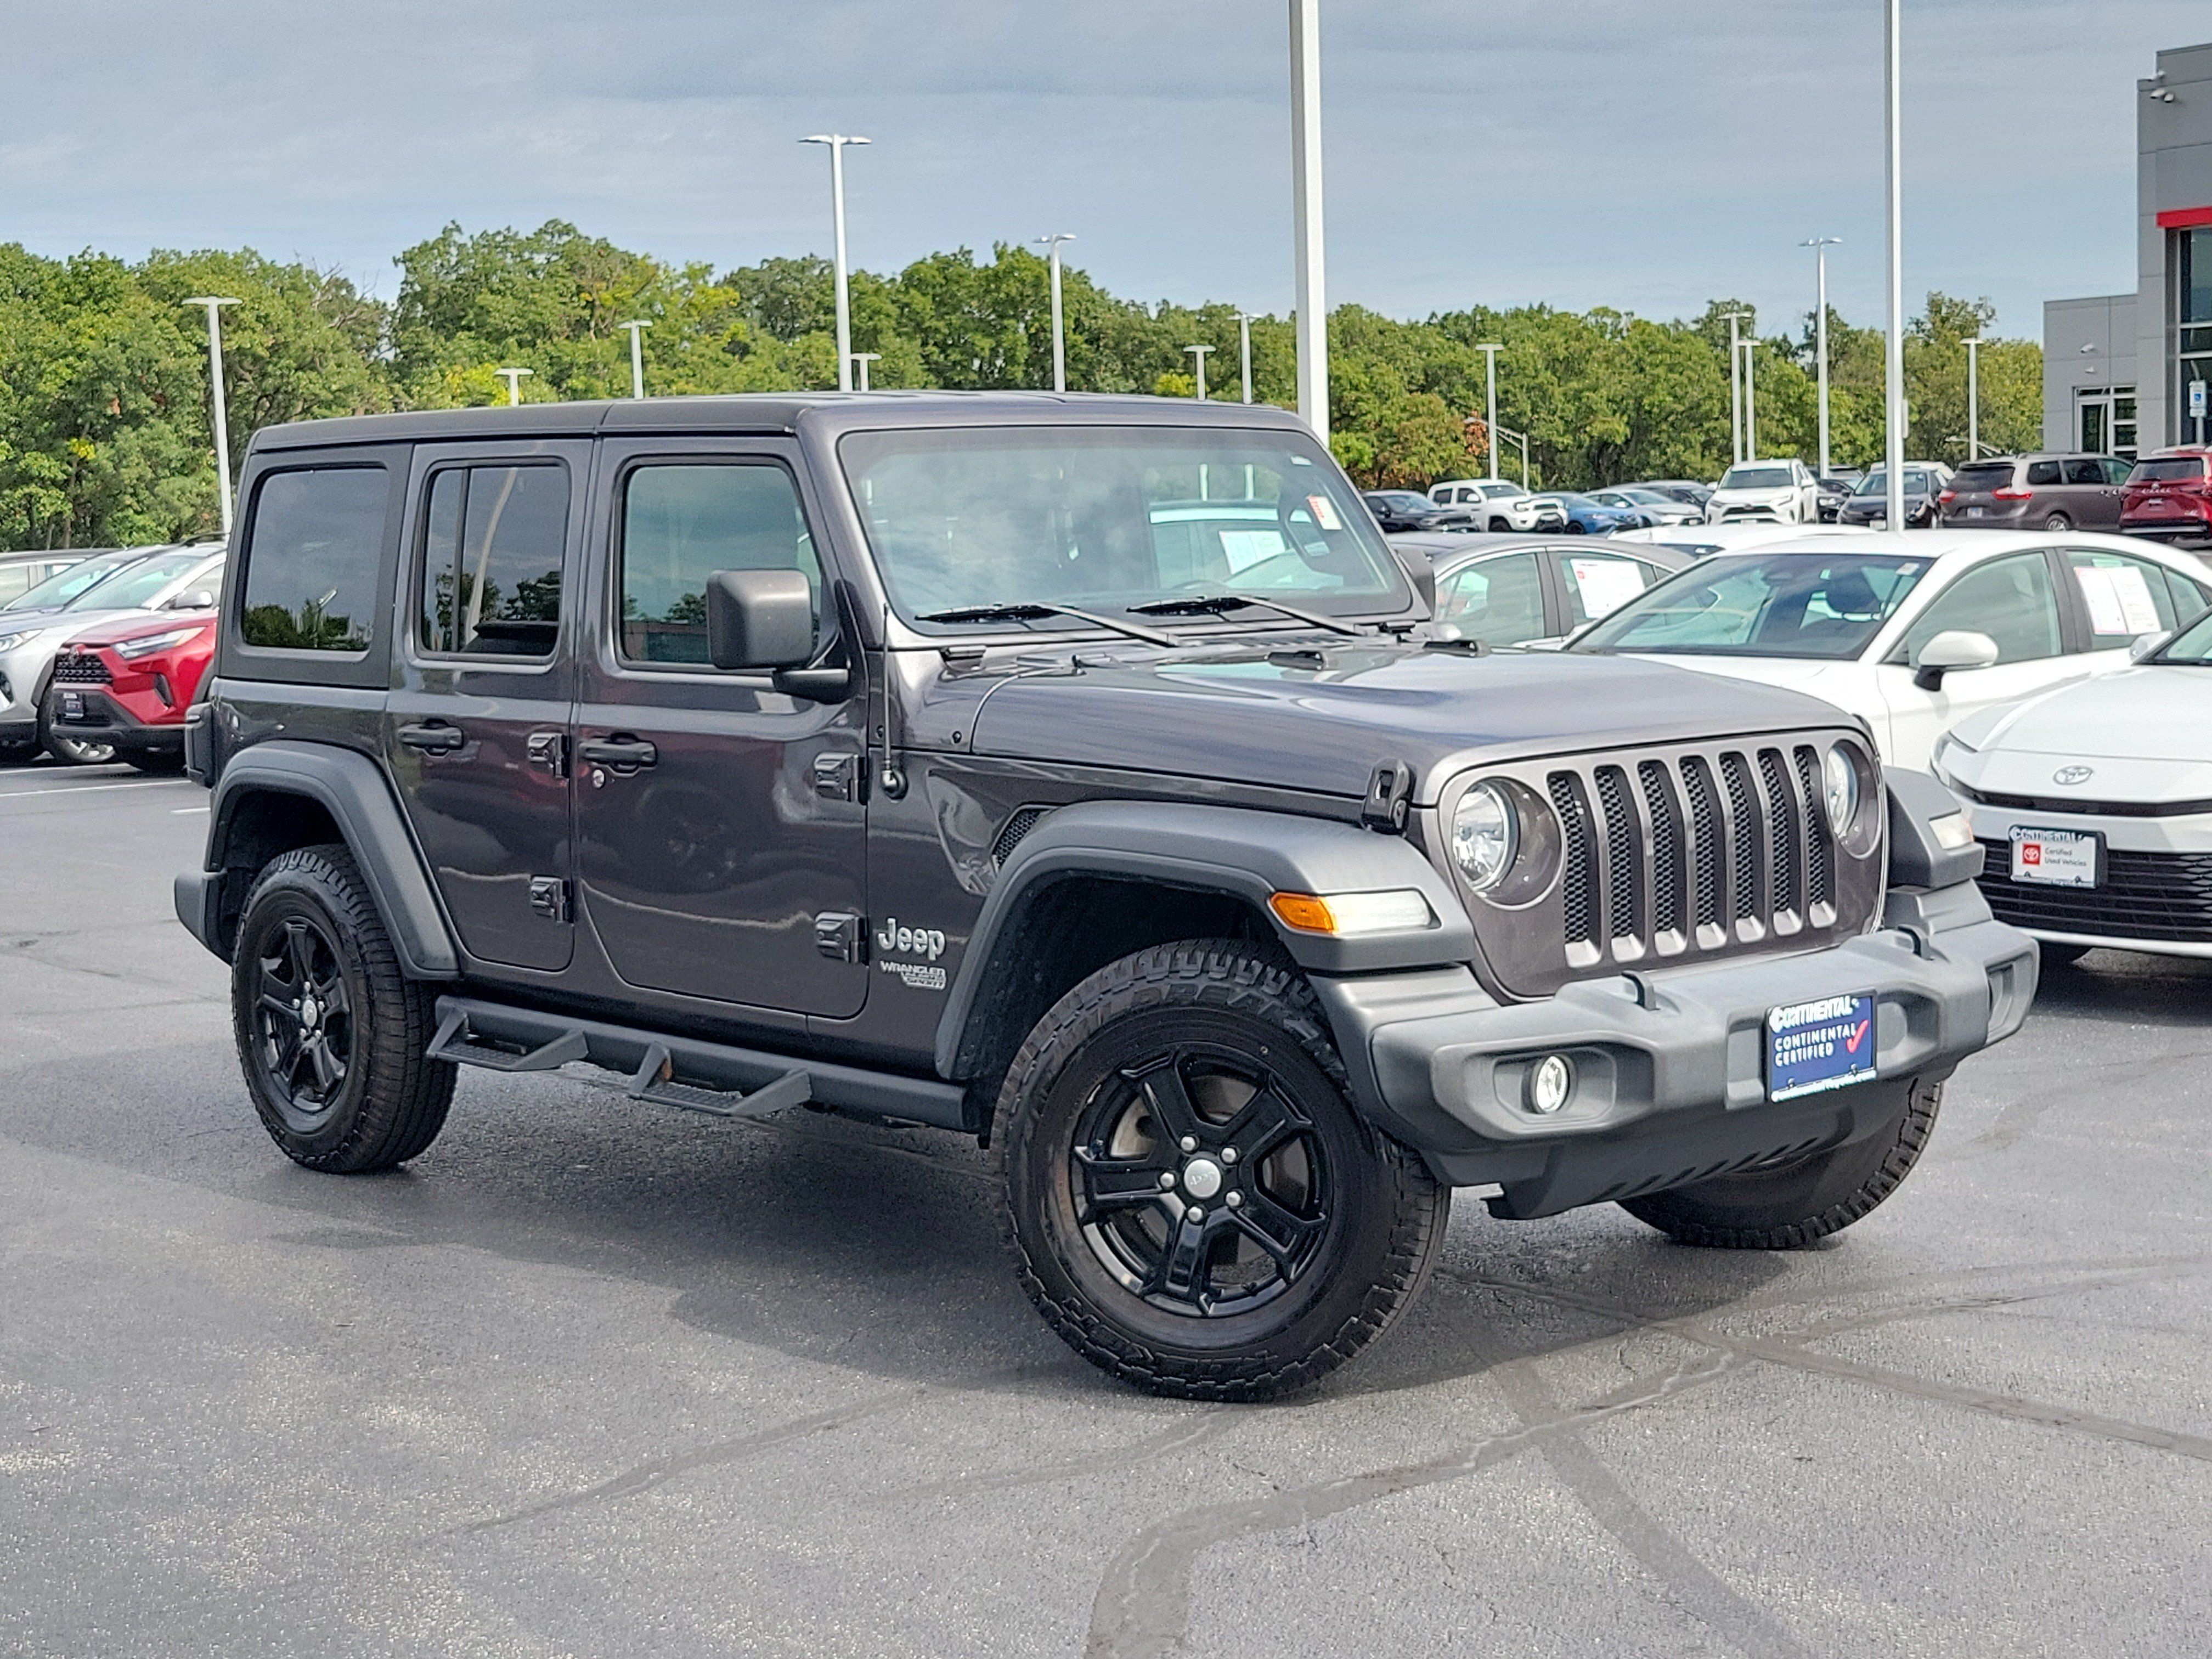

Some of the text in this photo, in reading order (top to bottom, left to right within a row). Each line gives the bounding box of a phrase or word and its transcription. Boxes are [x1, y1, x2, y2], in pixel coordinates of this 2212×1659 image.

[2045, 847, 2072, 856] Certified
[878, 918, 945, 960] Jeep
[1769, 995, 1853, 1033] CONTINENTAL
[1774, 1023, 1856, 1052] CONTINENTAL
[1775, 1042, 1834, 1067] CERTIFIED
